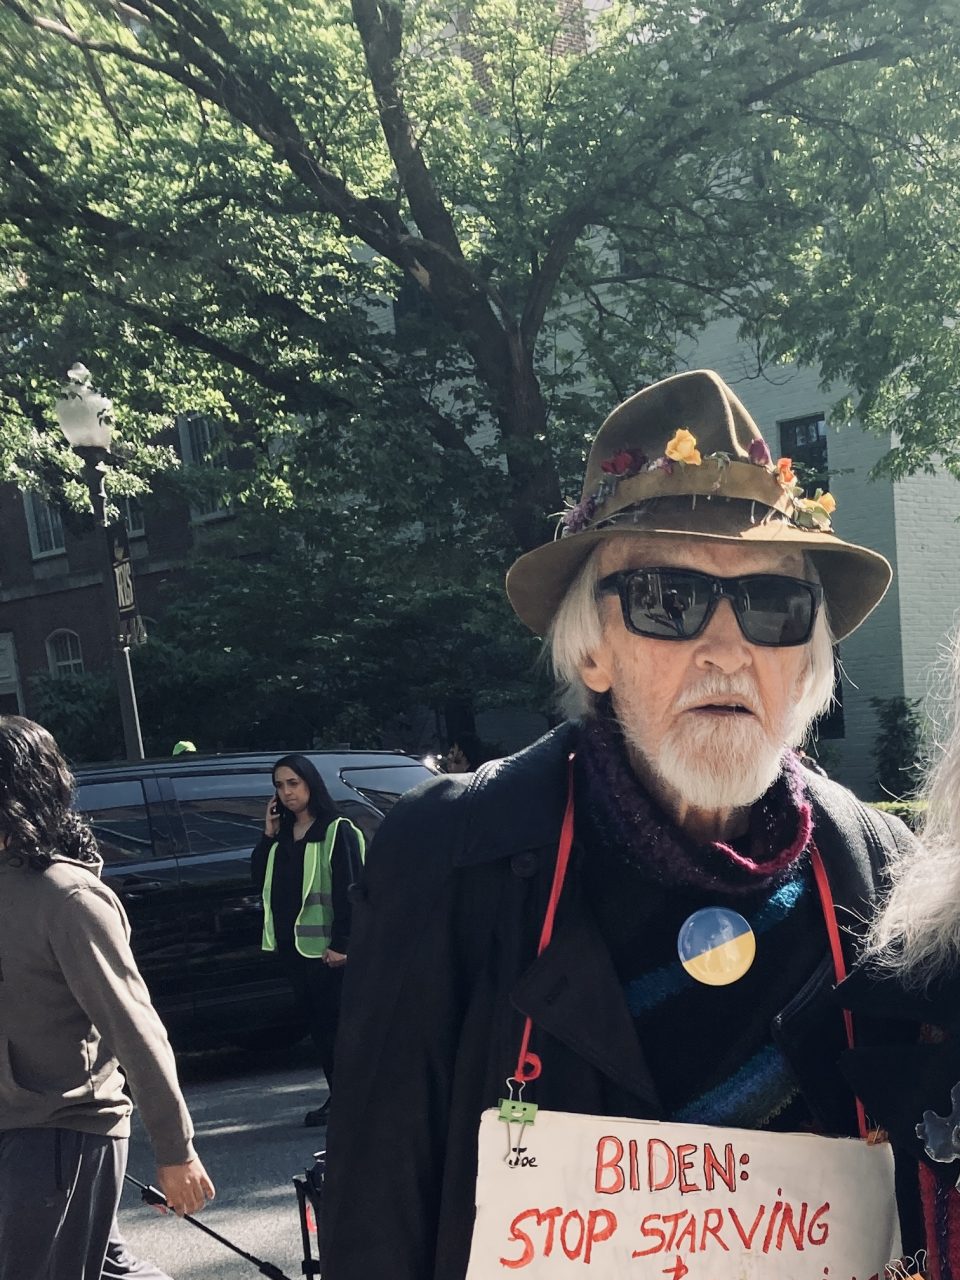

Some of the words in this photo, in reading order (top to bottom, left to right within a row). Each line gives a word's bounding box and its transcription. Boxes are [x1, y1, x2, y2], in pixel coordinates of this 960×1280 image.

[509, 1147, 538, 1168] Joe
[594, 1135, 750, 1194] BIDEN:
[500, 1206, 617, 1269] STOP
